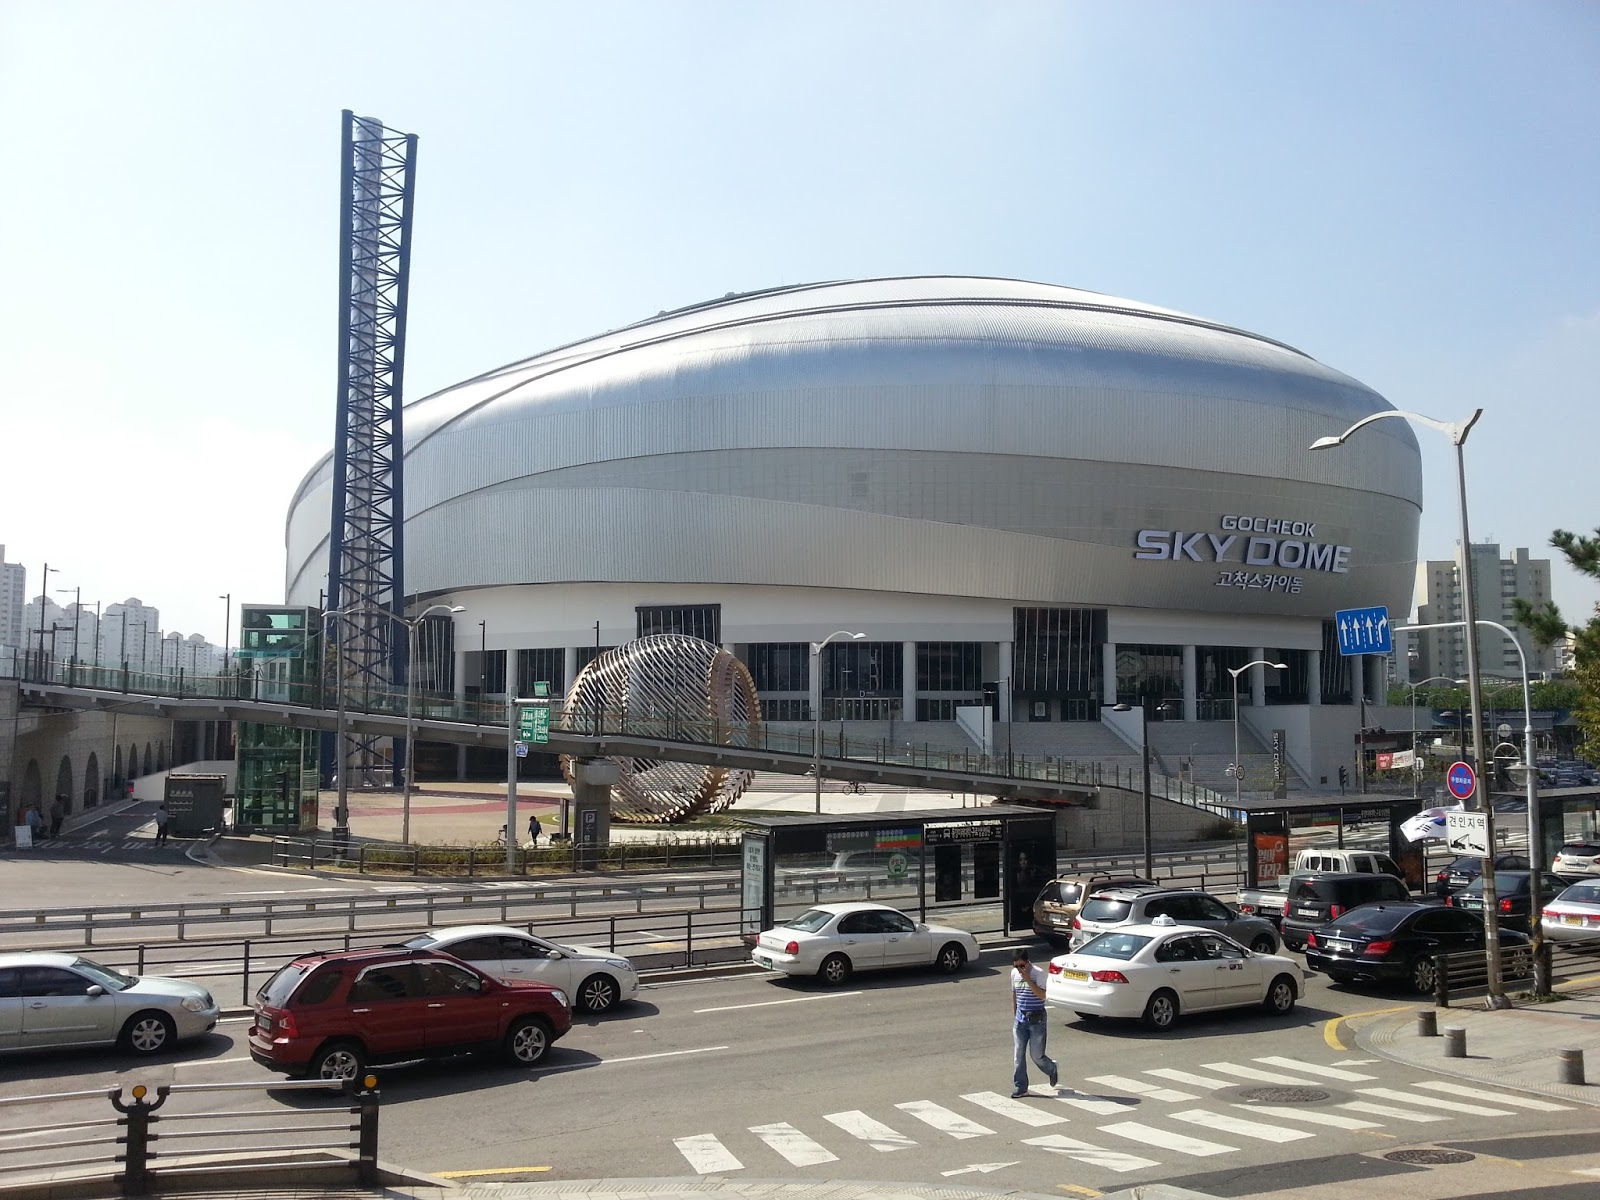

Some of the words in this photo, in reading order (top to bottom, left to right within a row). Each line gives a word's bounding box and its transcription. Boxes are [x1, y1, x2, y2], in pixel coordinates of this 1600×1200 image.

[1221, 514, 1317, 538] GOCHEOK
[1135, 529, 1238, 563] SKY
[1245, 536, 1352, 574] DOME
[1215, 571, 1304, 594] 고척스카이돔
[1449, 815, 1486, 830] 견인지역
